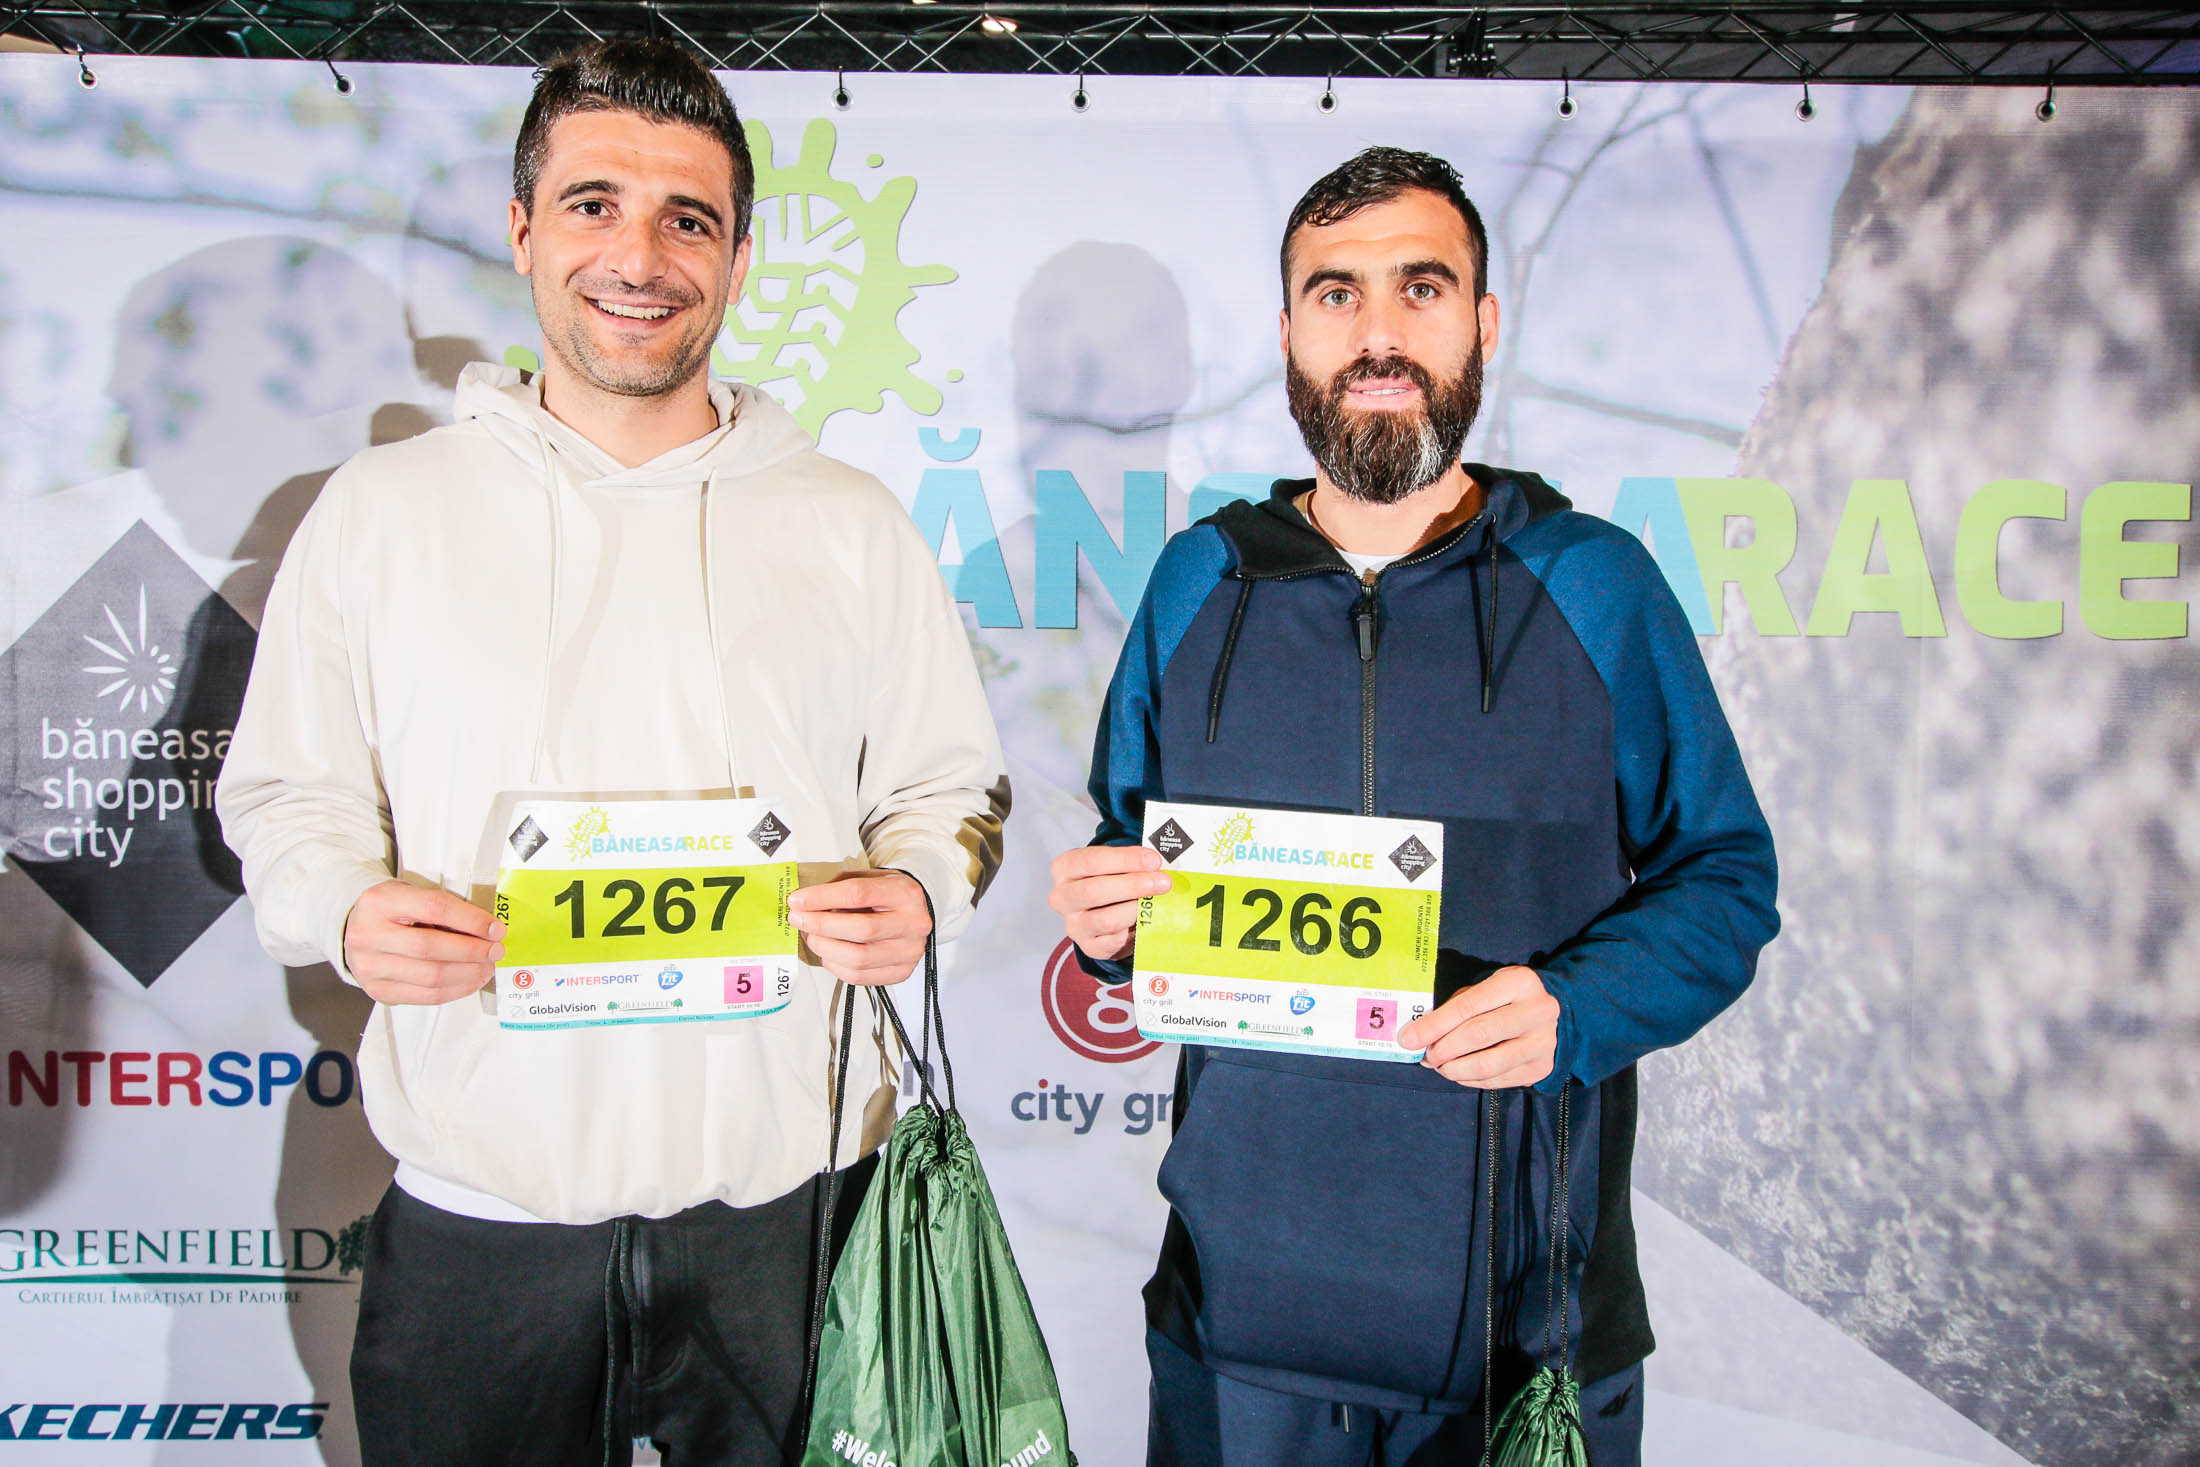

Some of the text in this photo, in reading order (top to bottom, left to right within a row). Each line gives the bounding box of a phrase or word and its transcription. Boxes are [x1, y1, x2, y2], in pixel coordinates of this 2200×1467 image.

[42, 717, 233, 760] băneasa
[43, 819, 133, 867] city
[496, 894, 509, 926] 267
[554, 875, 746, 939] 1267
[1195, 884, 1383, 960] 1266
[566, 974, 640, 987] INTERSPORT
[737, 973, 751, 994] 5
[777, 968, 790, 998] 1267
[1200, 990, 1272, 1005] INTERSPORT
[529, 1003, 597, 1015] GlobalVision
[1161, 1014, 1227, 1029] GlobalVision
[1369, 1006, 1385, 1030] 5
[8, 1050, 355, 1107] NTERSPO
[1010, 1078, 1105, 1135] city
[0, 1228, 336, 1273] GREENFIELD
[0, 1402, 330, 1441] KECHERS
